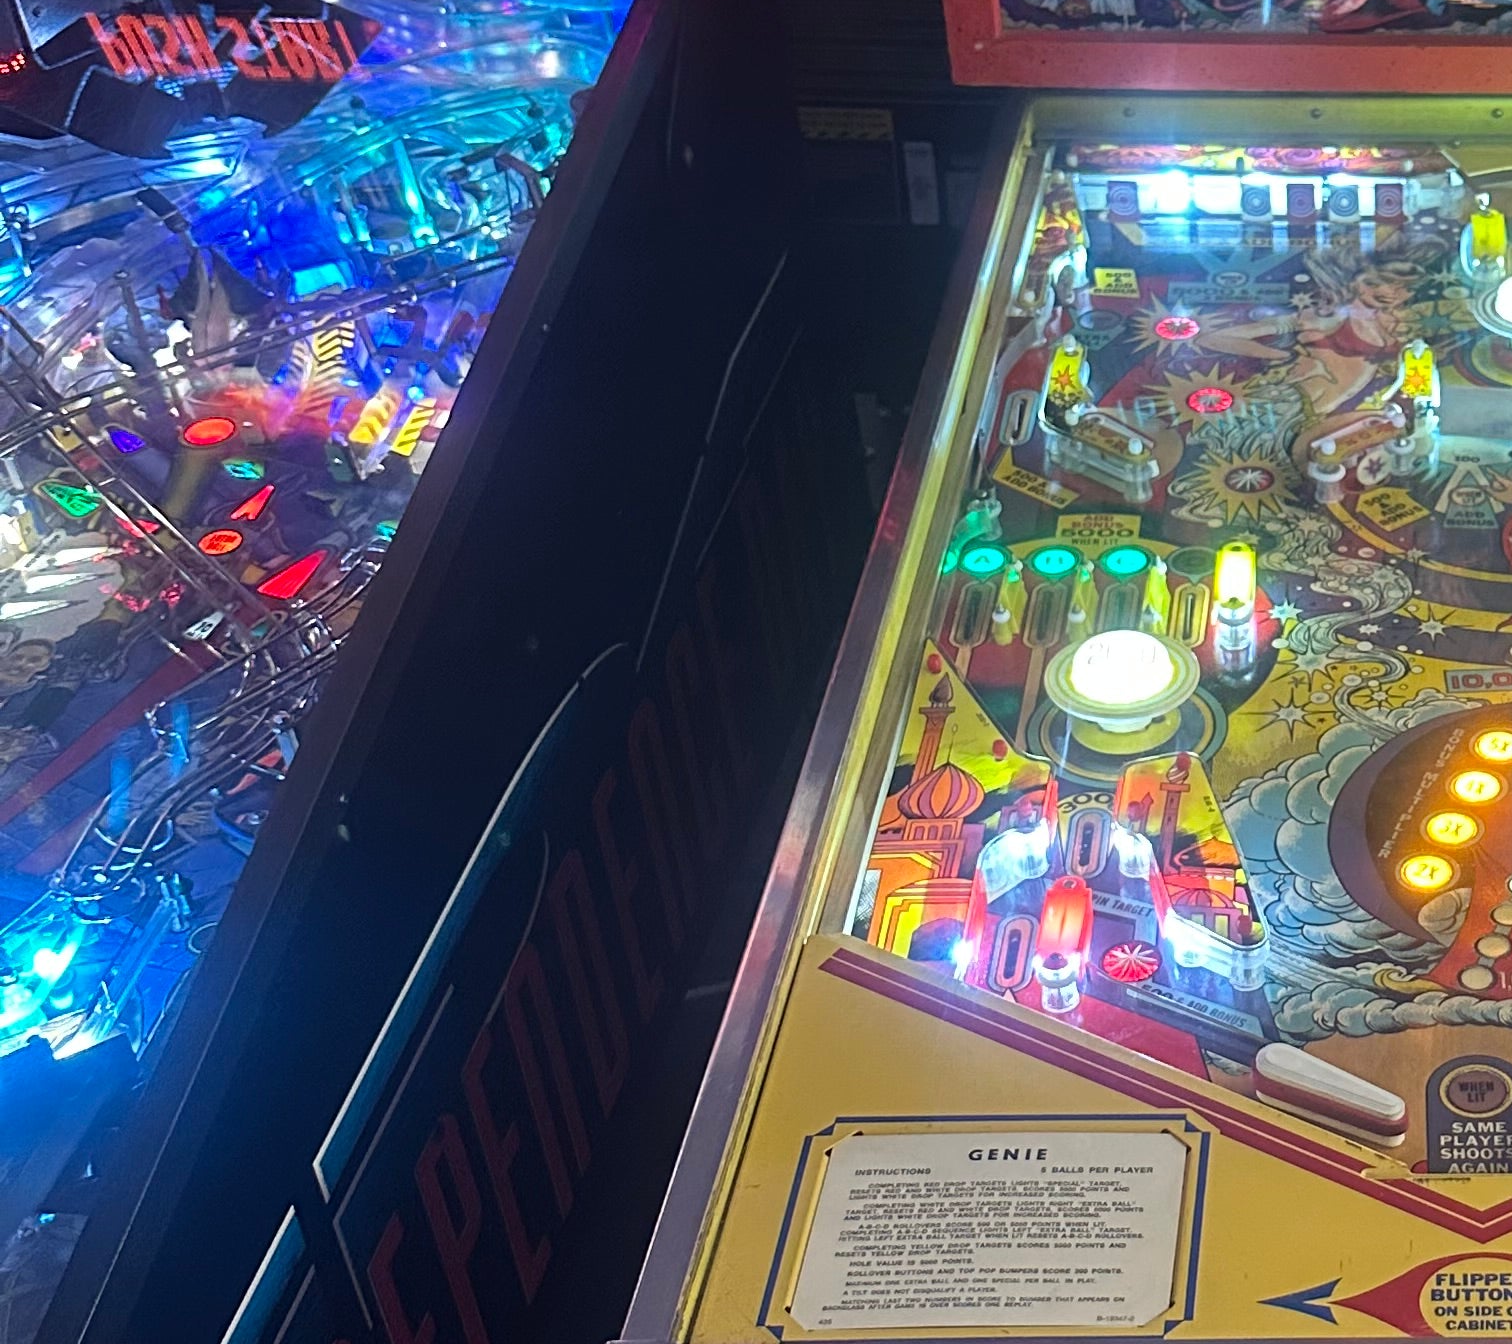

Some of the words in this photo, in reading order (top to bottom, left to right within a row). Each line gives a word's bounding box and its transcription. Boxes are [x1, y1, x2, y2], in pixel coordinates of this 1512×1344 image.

[1060, 528, 1134, 538] 5000
[1458, 1081, 1494, 1092] WHEN
[1467, 1091, 1487, 1103] LIT
[1451, 1121, 1508, 1134] SAME
[968, 1148, 1048, 1161] GENIE
[854, 1167, 932, 1176] INSTRUCTIONS
[1051, 1166, 1084, 1174] BALLS
[1088, 1166, 1109, 1174] PER
[1114, 1166, 1154, 1174] PLAYER
[1448, 1162, 1510, 1174] AGAIN
[1434, 1305, 1459, 1318] ON
[1463, 1305, 1506, 1318] SIDE
